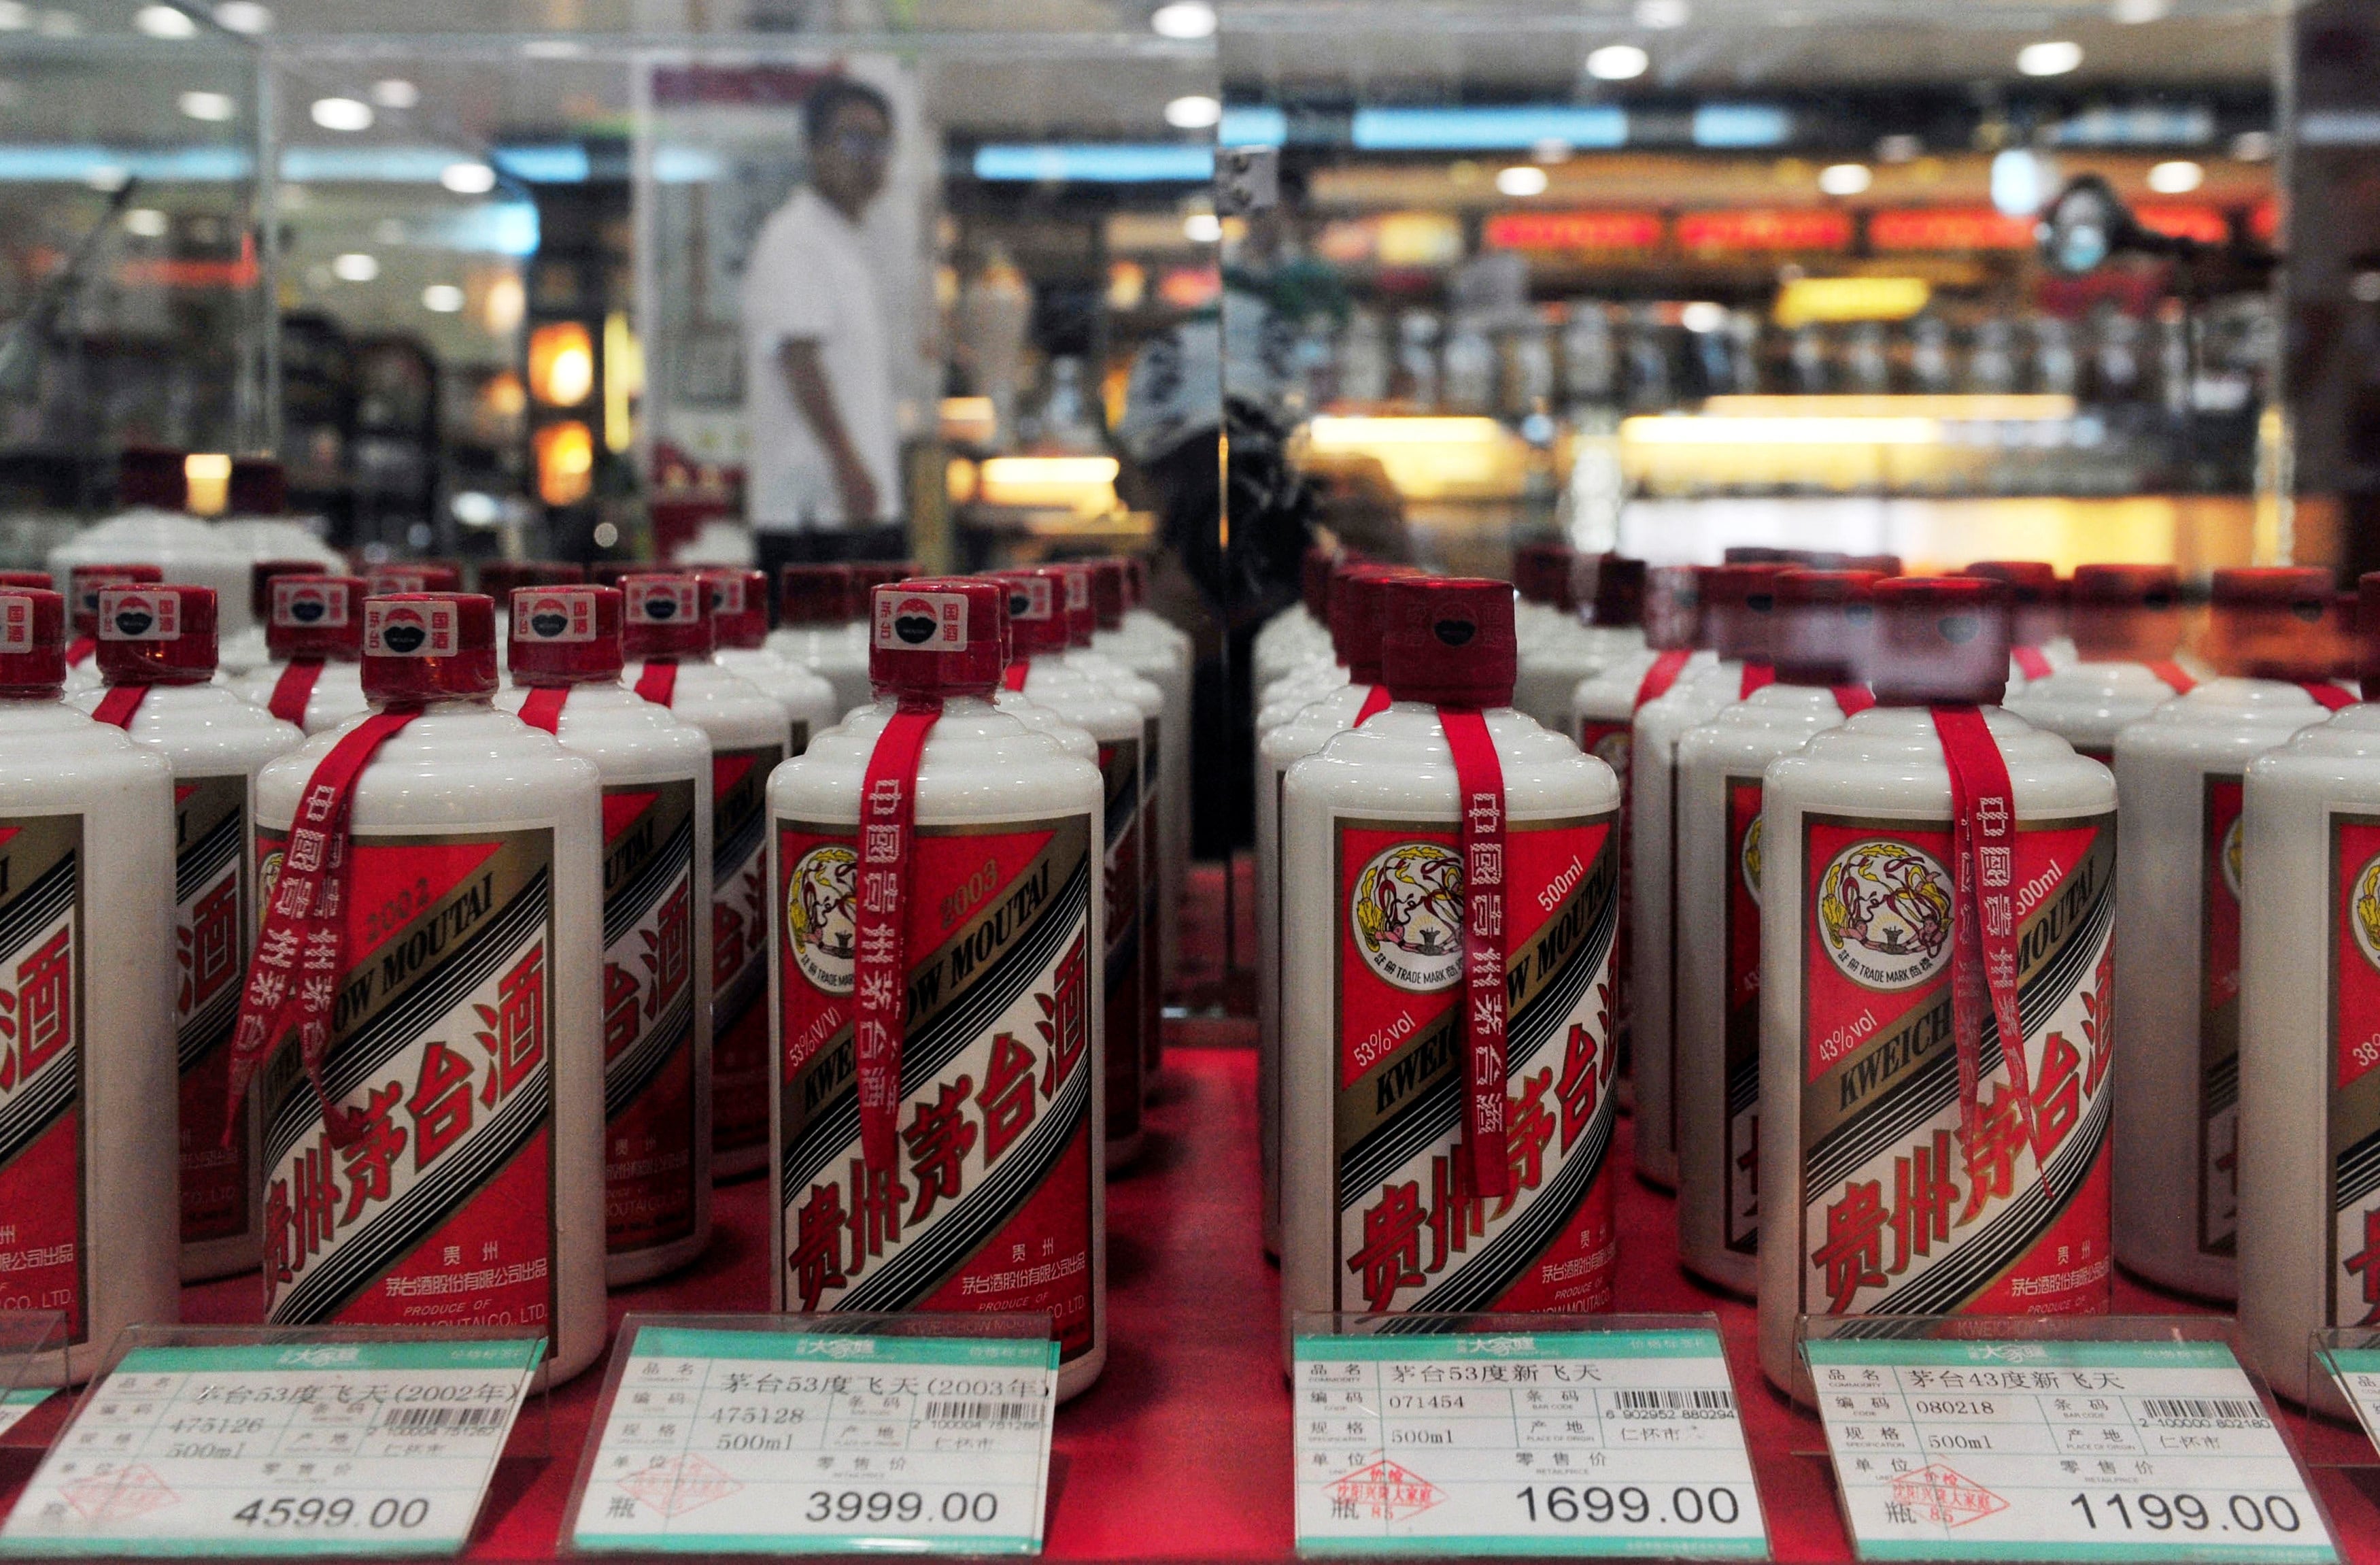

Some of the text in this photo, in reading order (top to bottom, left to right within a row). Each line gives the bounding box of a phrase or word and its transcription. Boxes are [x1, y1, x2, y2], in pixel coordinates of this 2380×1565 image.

[1537, 857, 1584, 913] 500ml
[382, 870, 494, 996] MOUTAI
[950, 859, 1050, 990] MOUTAI
[838, 973, 855, 986] MAR
[1396, 966, 1421, 984] TRADE
[1423, 969, 1447, 984] MARK
[1860, 964, 1884, 983] TRADE
[1886, 969, 1911, 983] MARK
[1554, 1281, 1593, 1301] PRODUCE
[403, 1298, 494, 1317] PRODUCE OF
[1392, 1363, 1603, 1384] 茅台53度新飞天
[1828, 1368, 1880, 1381] 品名
[1909, 1368, 2126, 1390] 茅台43度新飞天
[1389, 1394, 1465, 1411] 071454
[1916, 1400, 1994, 1415] 080218
[713, 1406, 805, 1425] 475128
[1622, 1410, 1676, 1420] 902952
[1682, 1410, 1735, 1420] 880294
[2157, 1418, 2211, 1428] 100000
[716, 1433, 794, 1452] 500ml
[1392, 1428, 1455, 1445] 500ml
[1928, 1434, 1992, 1450] 500ml
[234, 1497, 430, 1530] 4599.00
[804, 1490, 999, 1525] 3999.00
[1516, 1485, 1740, 1525] 1699.00
[2069, 1492, 2300, 1534] 1199.00
